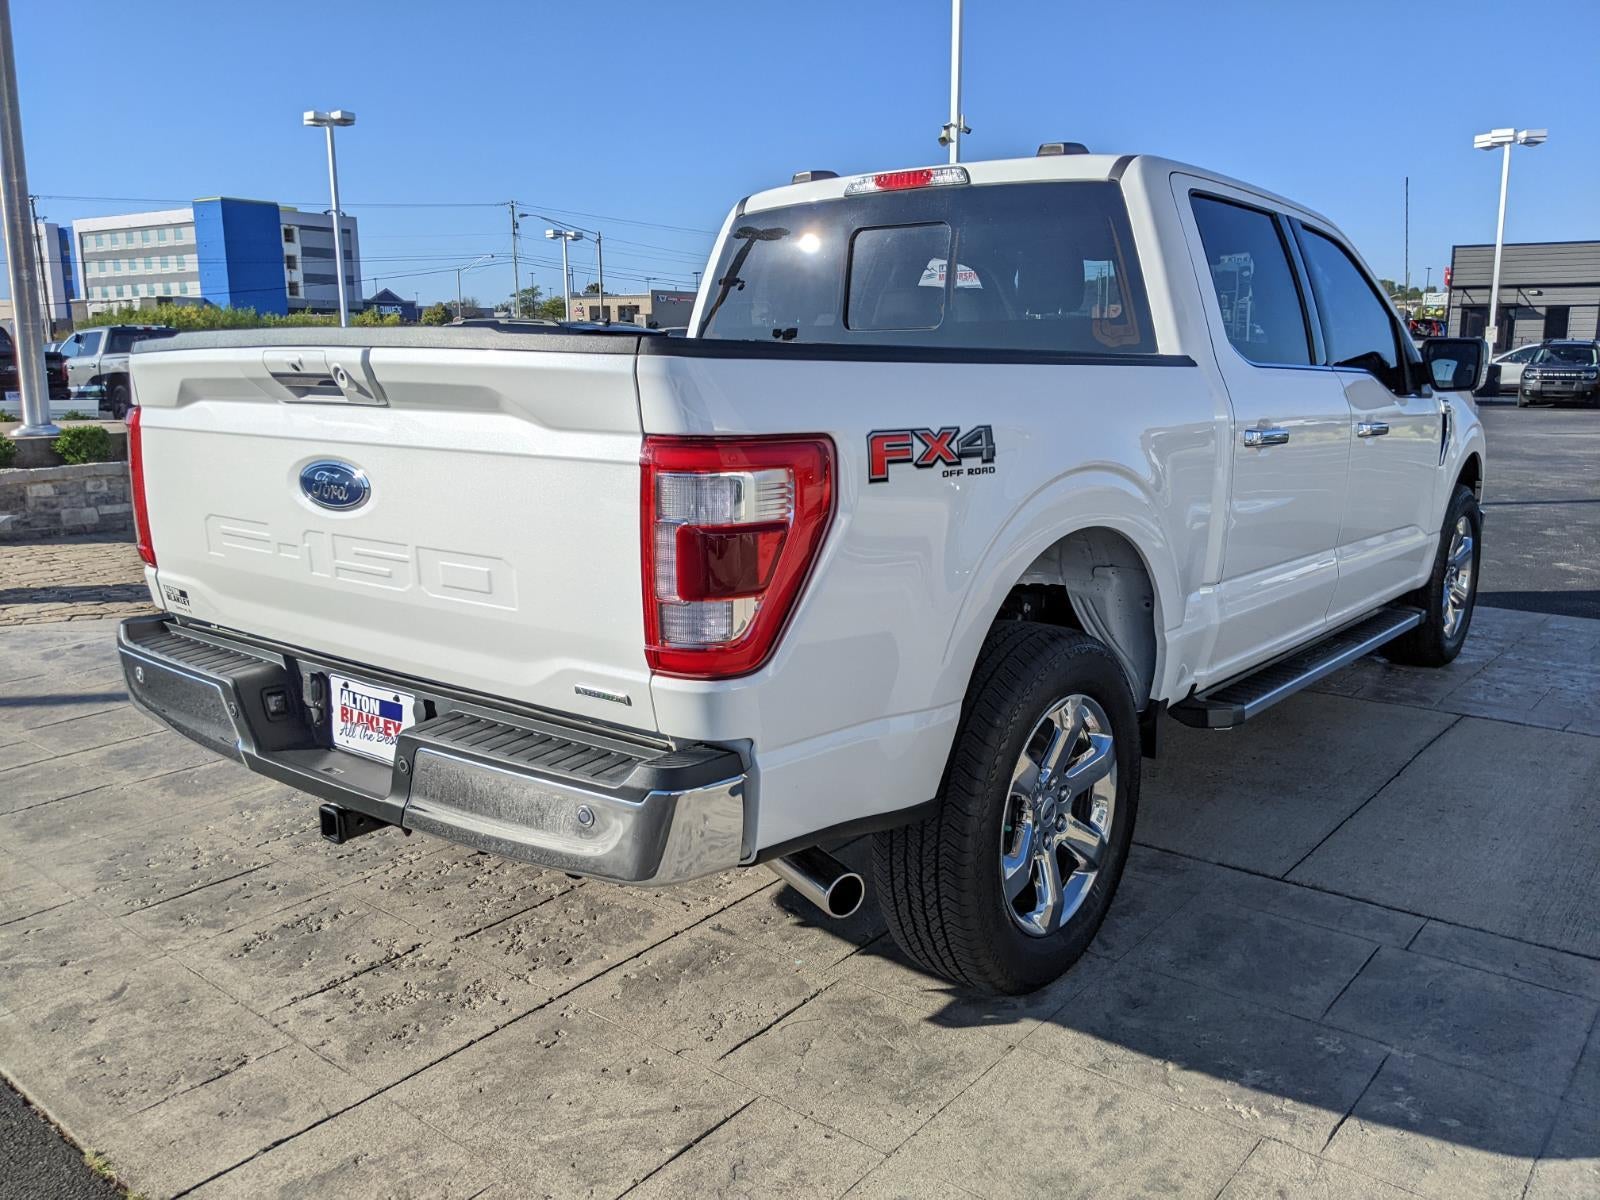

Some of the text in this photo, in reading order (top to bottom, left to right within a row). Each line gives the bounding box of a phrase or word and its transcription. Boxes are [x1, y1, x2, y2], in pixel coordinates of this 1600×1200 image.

[866, 425, 996, 484] FX4
[312, 471, 349, 501] Ford
[942, 466, 996, 478] OFF ROAD
[204, 513, 518, 611] F-150
[341, 690, 380, 715] ALTON
[340, 720, 358, 738] All
[358, 722, 375, 742] The
[341, 706, 402, 737] BLAKLEY
